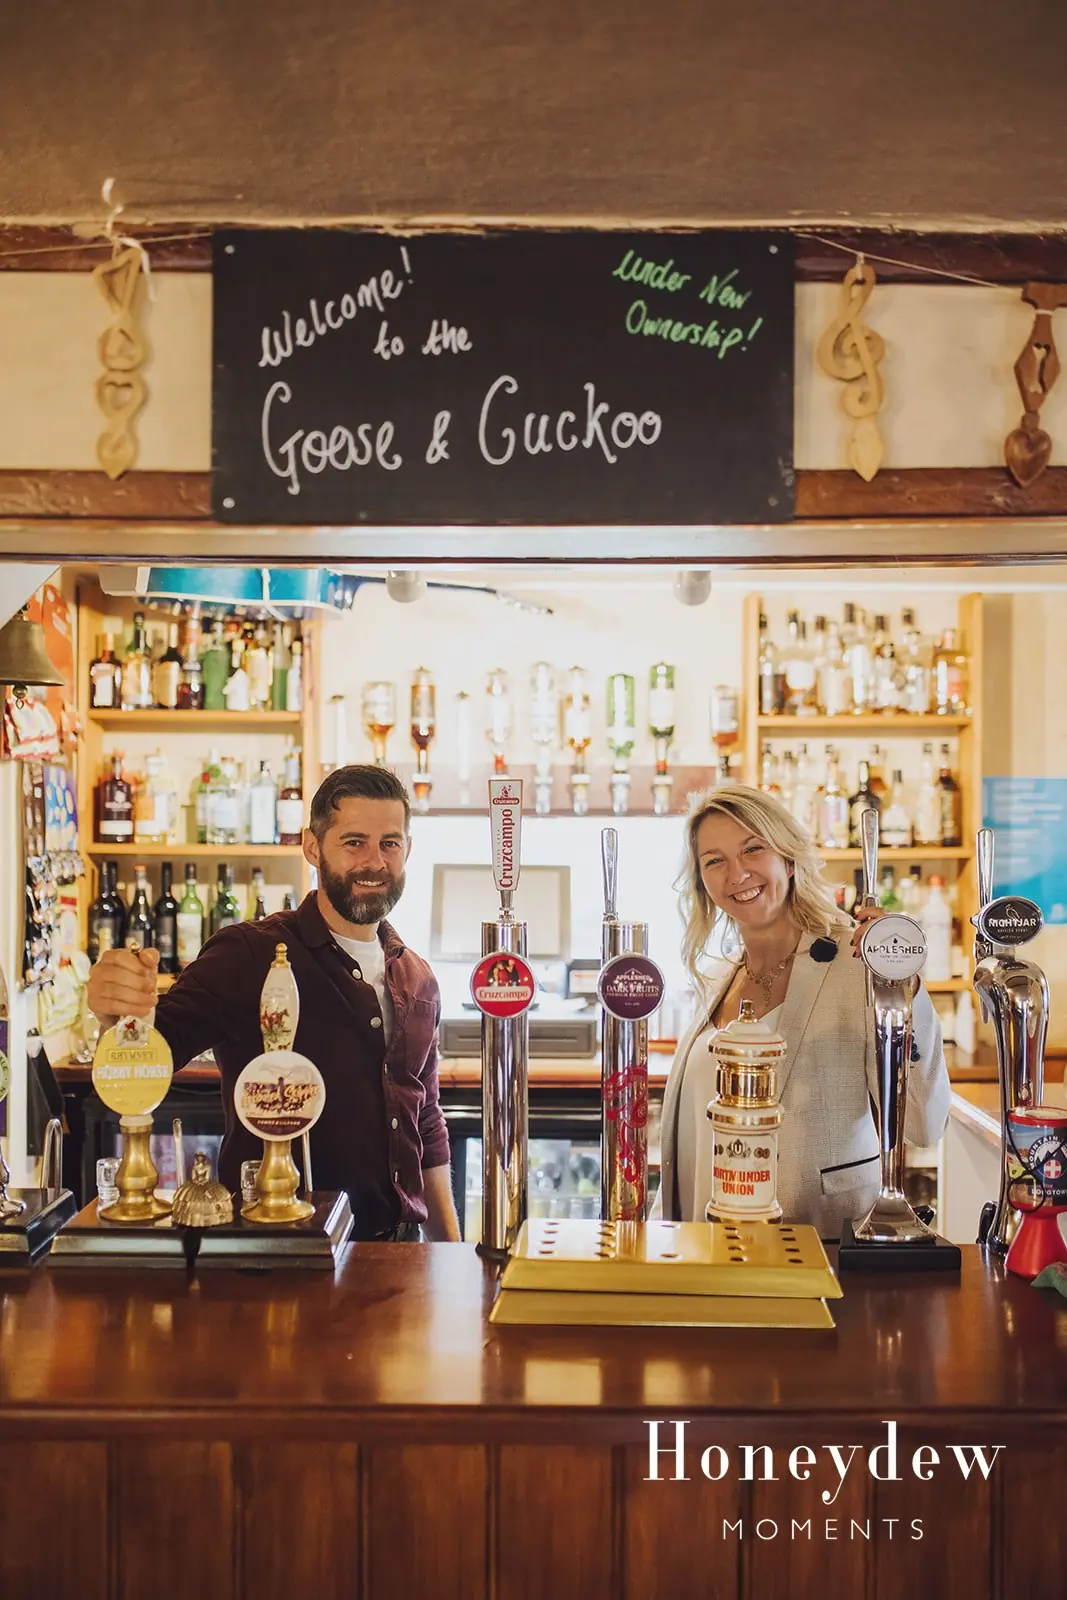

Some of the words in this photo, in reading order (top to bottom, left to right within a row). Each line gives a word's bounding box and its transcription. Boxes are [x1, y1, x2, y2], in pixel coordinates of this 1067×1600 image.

[612, 249, 692, 292] Under
[699, 268, 752, 309] New
[258, 245, 414, 367] Welcome!
[373, 320, 405, 360] to
[421, 318, 473, 355] the
[626, 300, 763, 359] Ownership!
[262, 381, 402, 495] Goose
[426, 410, 451, 464] &
[479, 374, 662, 465] Cuckoo
[499, 808, 515, 888] Cruzcampo
[867, 945, 924, 955] APPLESHED
[480, 990, 528, 999] Cruzcampo
[606, 984, 628, 993] DARK
[629, 984, 660, 993] FRUITS
[1029, 1135, 1059, 1170] MOUNTAIN
[722, 1182, 754, 1195] UNION
